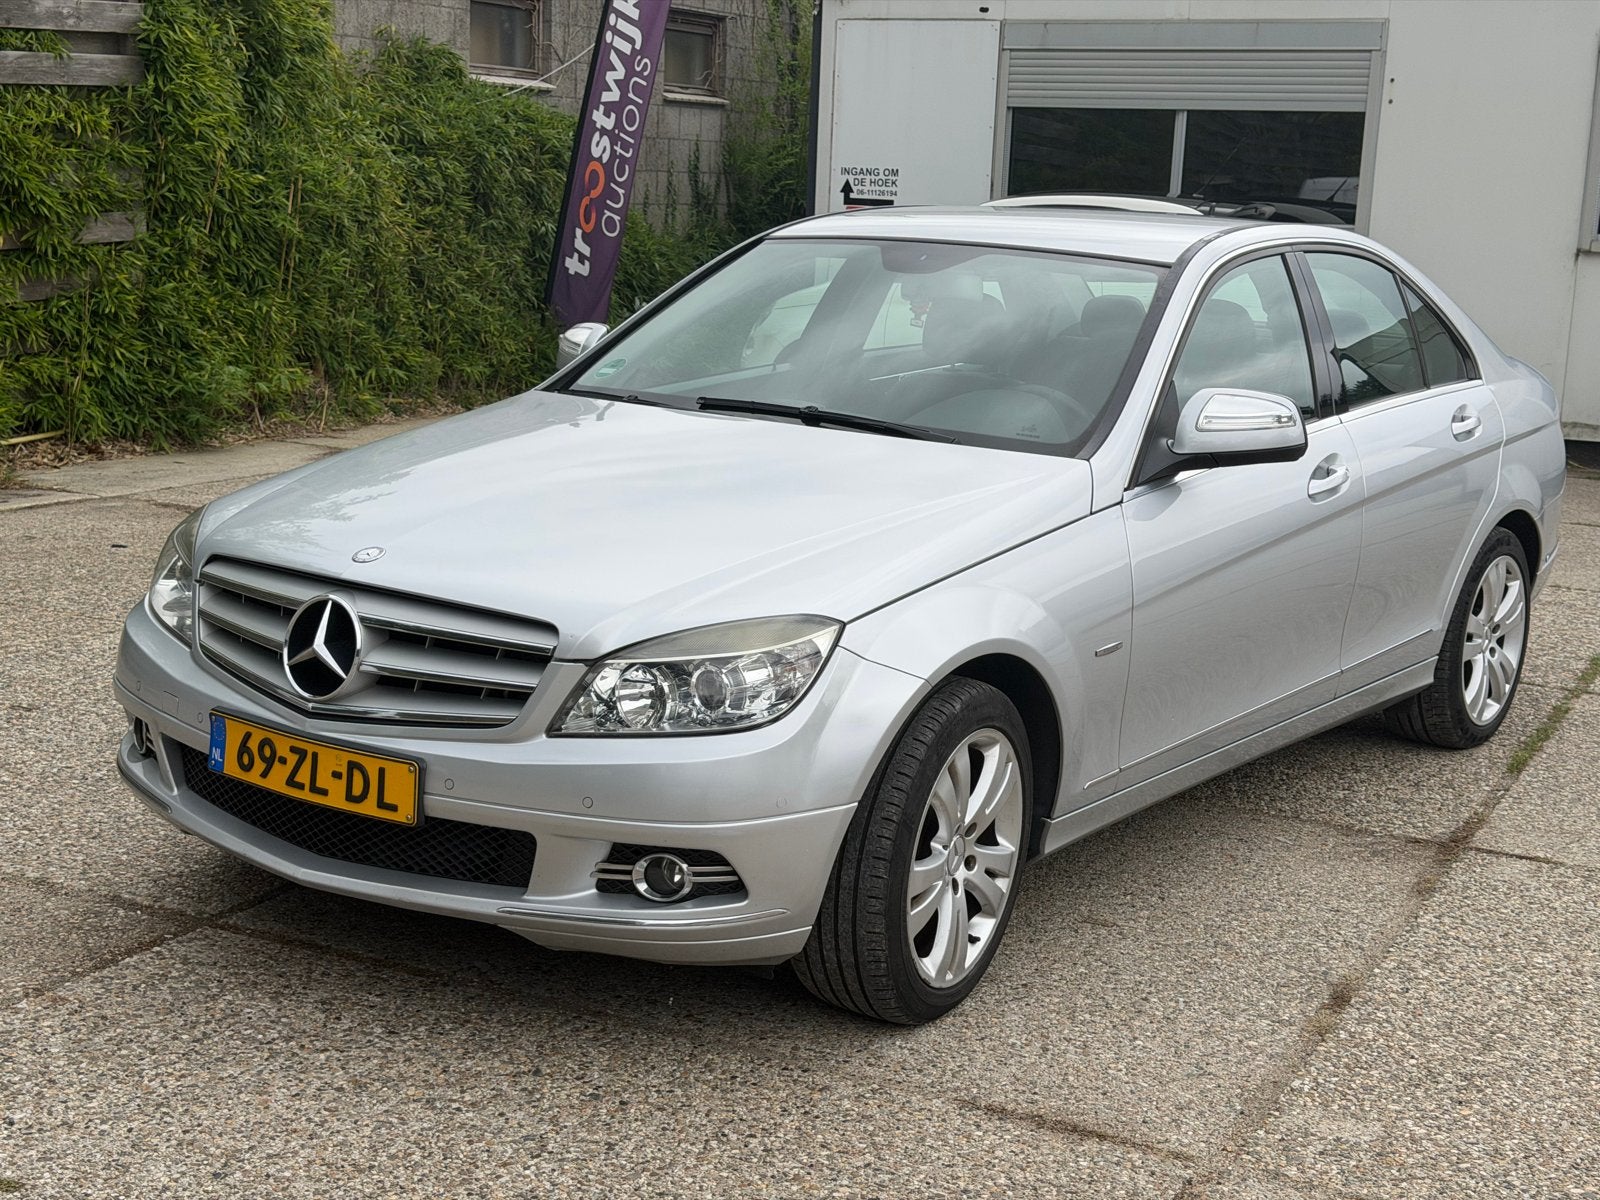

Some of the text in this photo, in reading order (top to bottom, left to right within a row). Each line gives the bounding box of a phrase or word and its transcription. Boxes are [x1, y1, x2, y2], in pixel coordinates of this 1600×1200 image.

[602, 55, 651, 237] auctions
[841, 167, 899, 177] INGANG OM
[853, 178, 898, 187] DE HOEK
[856, 189, 898, 197] 06-11126194
[211, 746, 224, 762] NL
[236, 731, 399, 812] 69-ZL-DL
